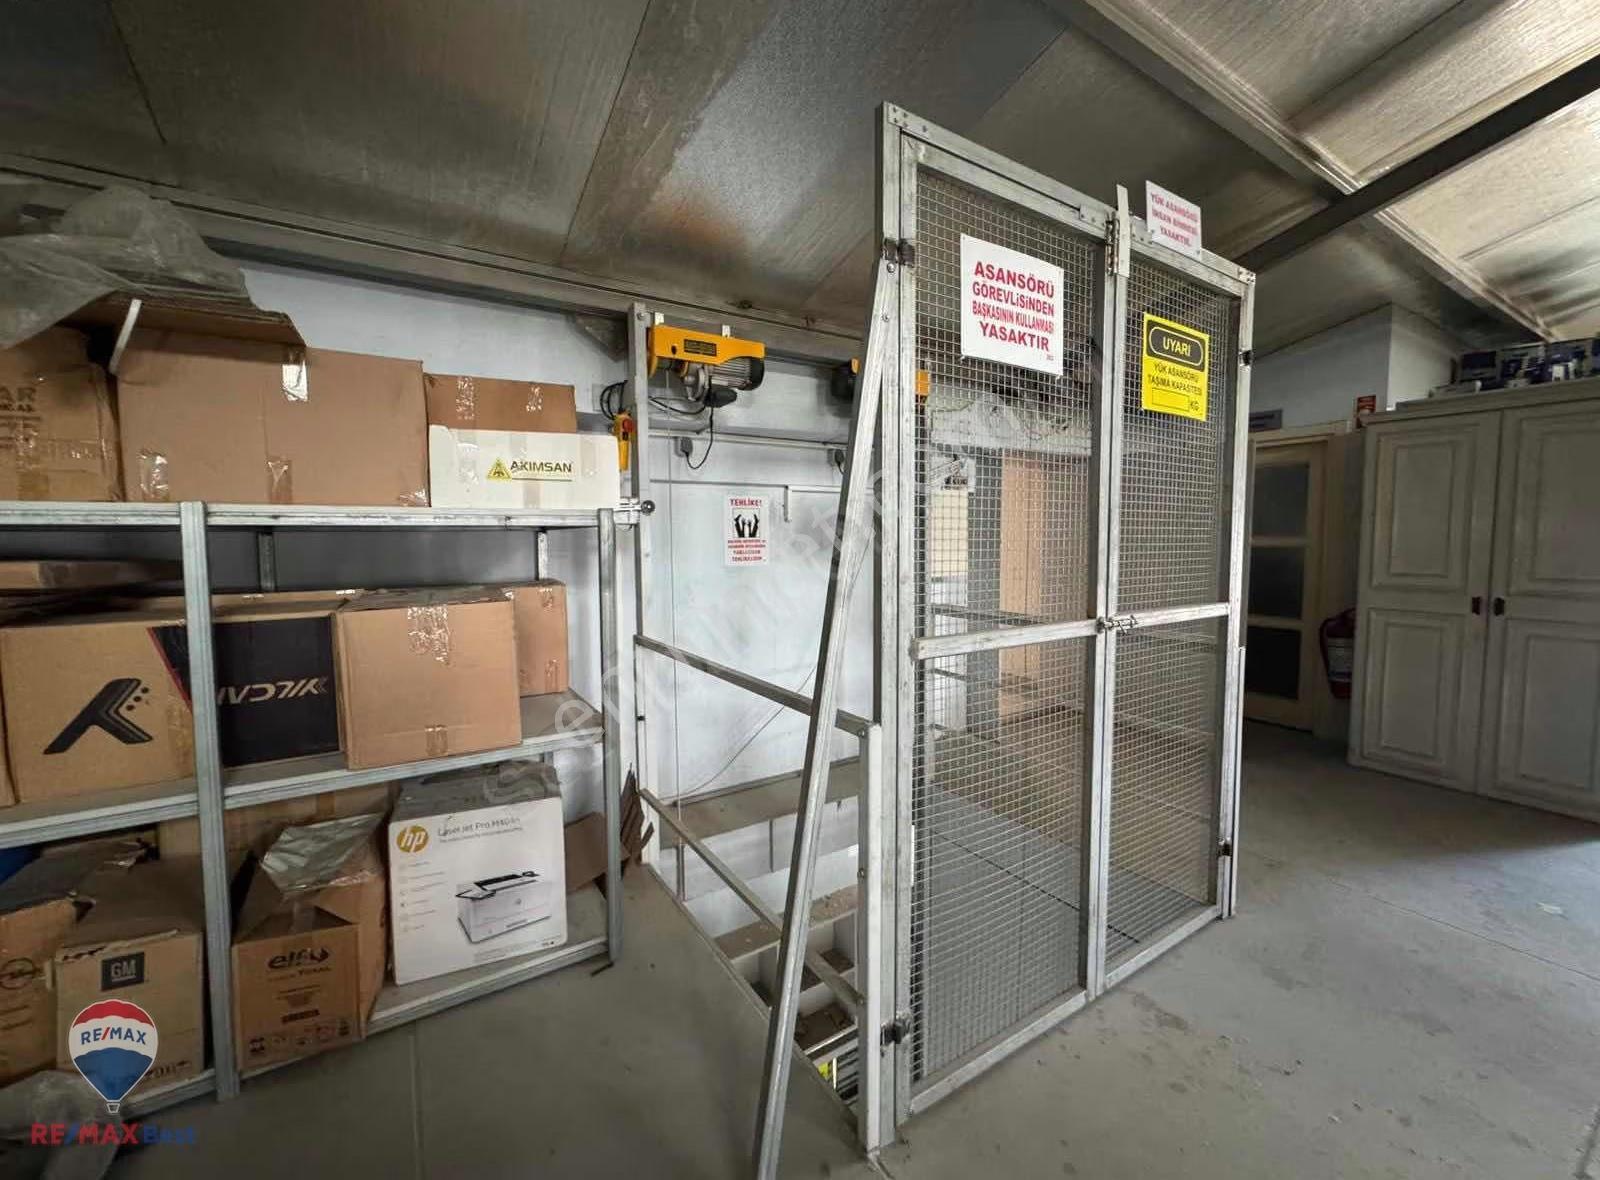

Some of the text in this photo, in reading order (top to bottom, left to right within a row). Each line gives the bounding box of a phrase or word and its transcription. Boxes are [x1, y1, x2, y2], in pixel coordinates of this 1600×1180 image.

[974, 261, 1054, 298] ASANSÖRÜ
[972, 301, 1054, 334] BAŞKASININ KULLANMASI
[979, 320, 1049, 351] YASAKTIR
[1162, 336, 1191, 357] UYARI
[1148, 375, 1170, 388] TAŞIMA
[1154, 362, 1199, 383] YÜK ASANSÖRÜ
[1190, 398, 1199, 411] KG
[510, 460, 572, 473] AKIMSAN
[400, 827, 426, 852] hp
[111, 960, 136, 978] GM
